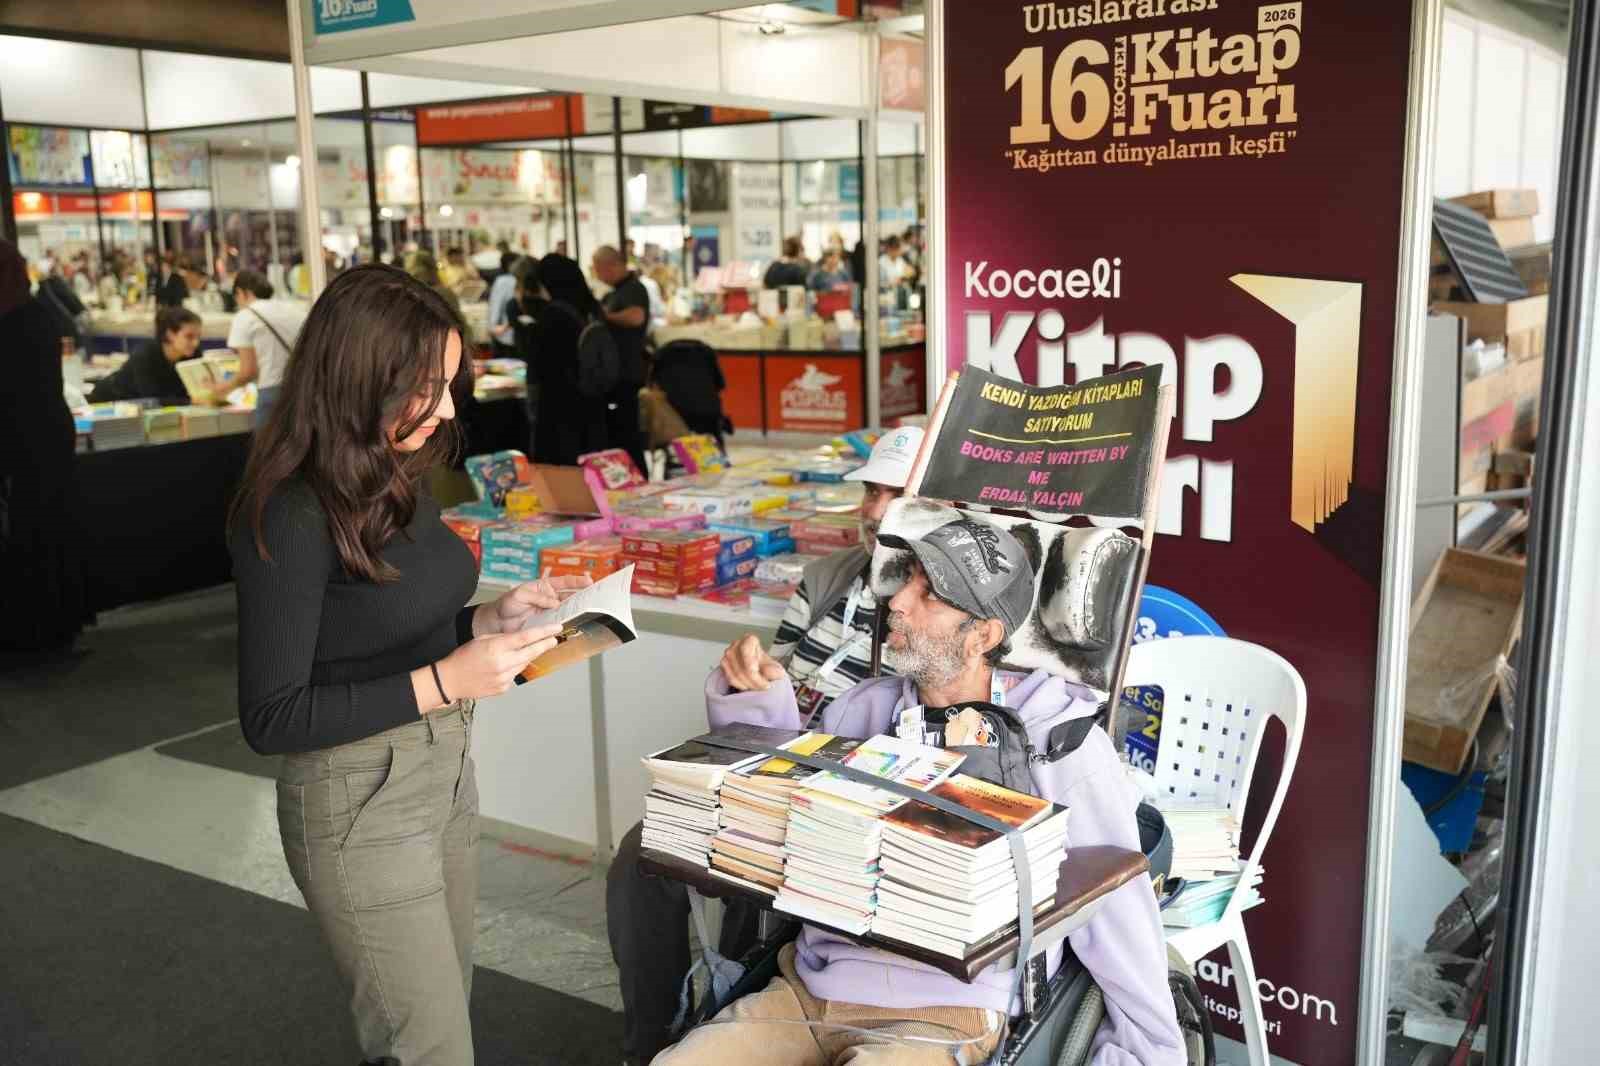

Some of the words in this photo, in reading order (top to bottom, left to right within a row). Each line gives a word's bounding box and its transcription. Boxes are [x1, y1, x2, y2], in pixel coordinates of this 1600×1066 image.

[1264, 8, 1297, 22] 2026
[1130, 25, 1301, 84] Kitap
[1129, 83, 1299, 137] Fuarı
[1104, 138, 1221, 166] dünyaların
[964, 257, 1121, 299] Kocaeli
[980, 381, 1027, 409] KENDİ
[1082, 378, 1144, 405] KİTAPLARI
[1023, 412, 1094, 433] SATIYORUM
[960, 440, 1013, 464] BOOKS
[1014, 450, 1045, 465] ARE
[1046, 451, 1106, 465] WRITTEN
[1108, 445, 1129, 462] BY
[1027, 470, 1051, 485] ME
[978, 486, 1027, 503] ERDAL
[1032, 491, 1083, 510] YALÇIN
